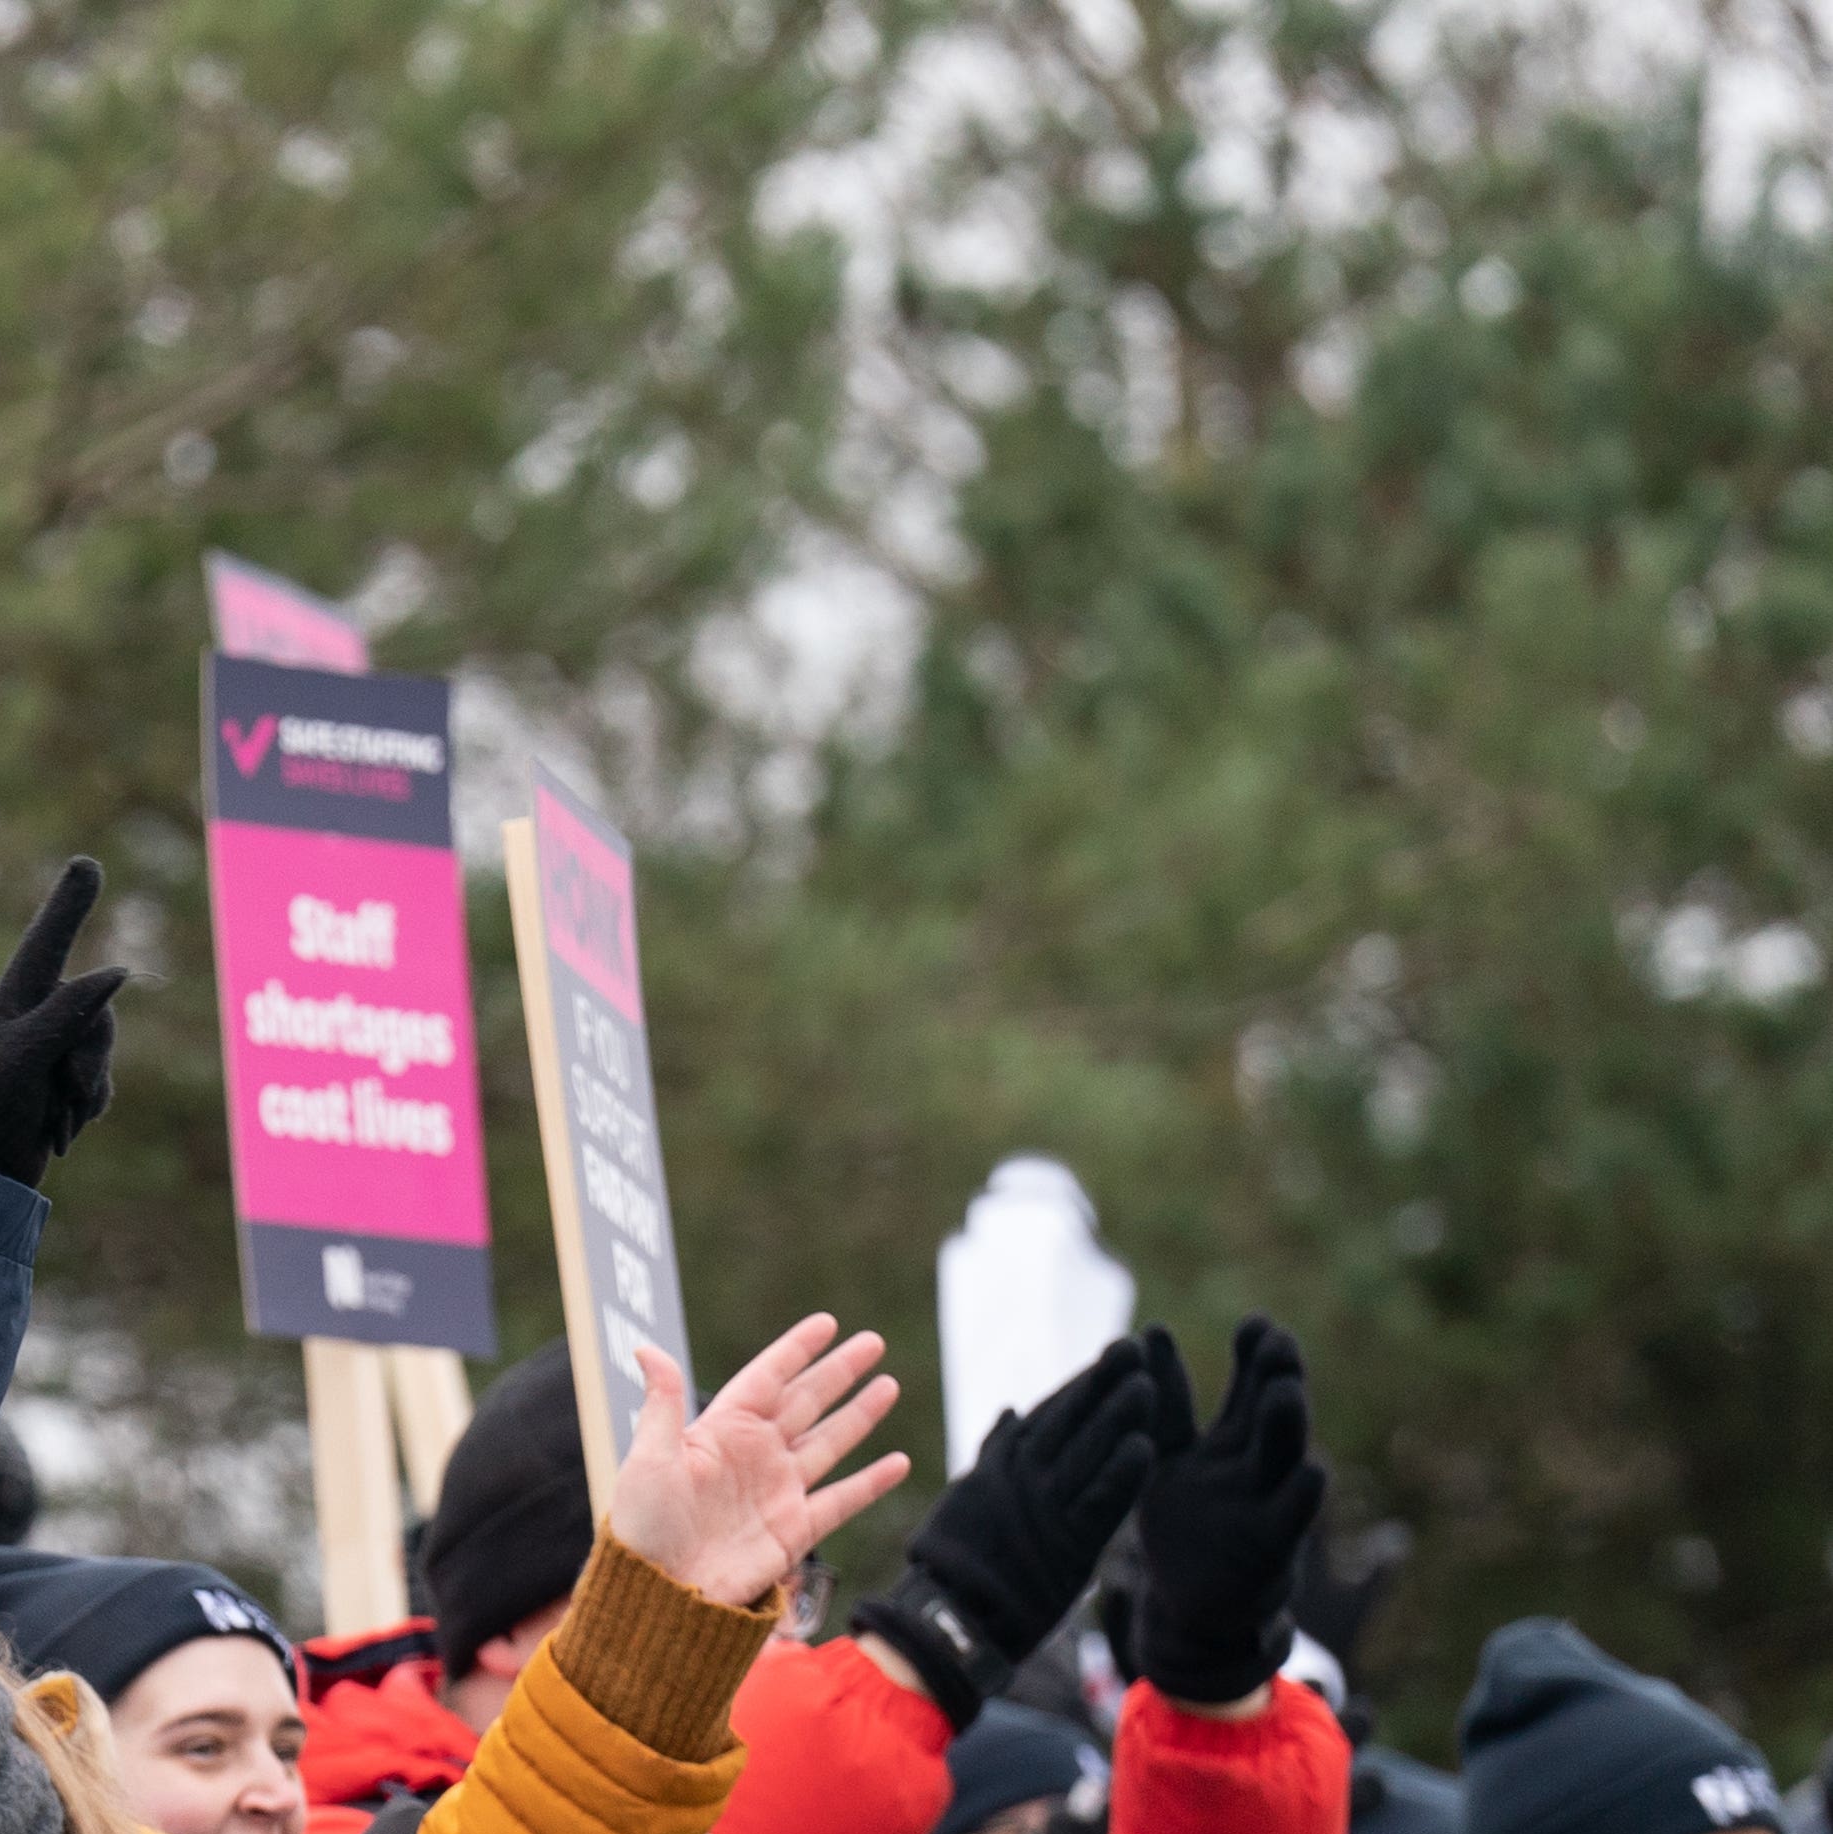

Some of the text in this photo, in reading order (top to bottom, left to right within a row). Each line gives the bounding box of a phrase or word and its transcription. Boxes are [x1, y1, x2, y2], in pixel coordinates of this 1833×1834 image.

[289, 894, 396, 969] Staff
[244, 979, 455, 1075] shortages
[259, 1076, 455, 1157] cost lives
